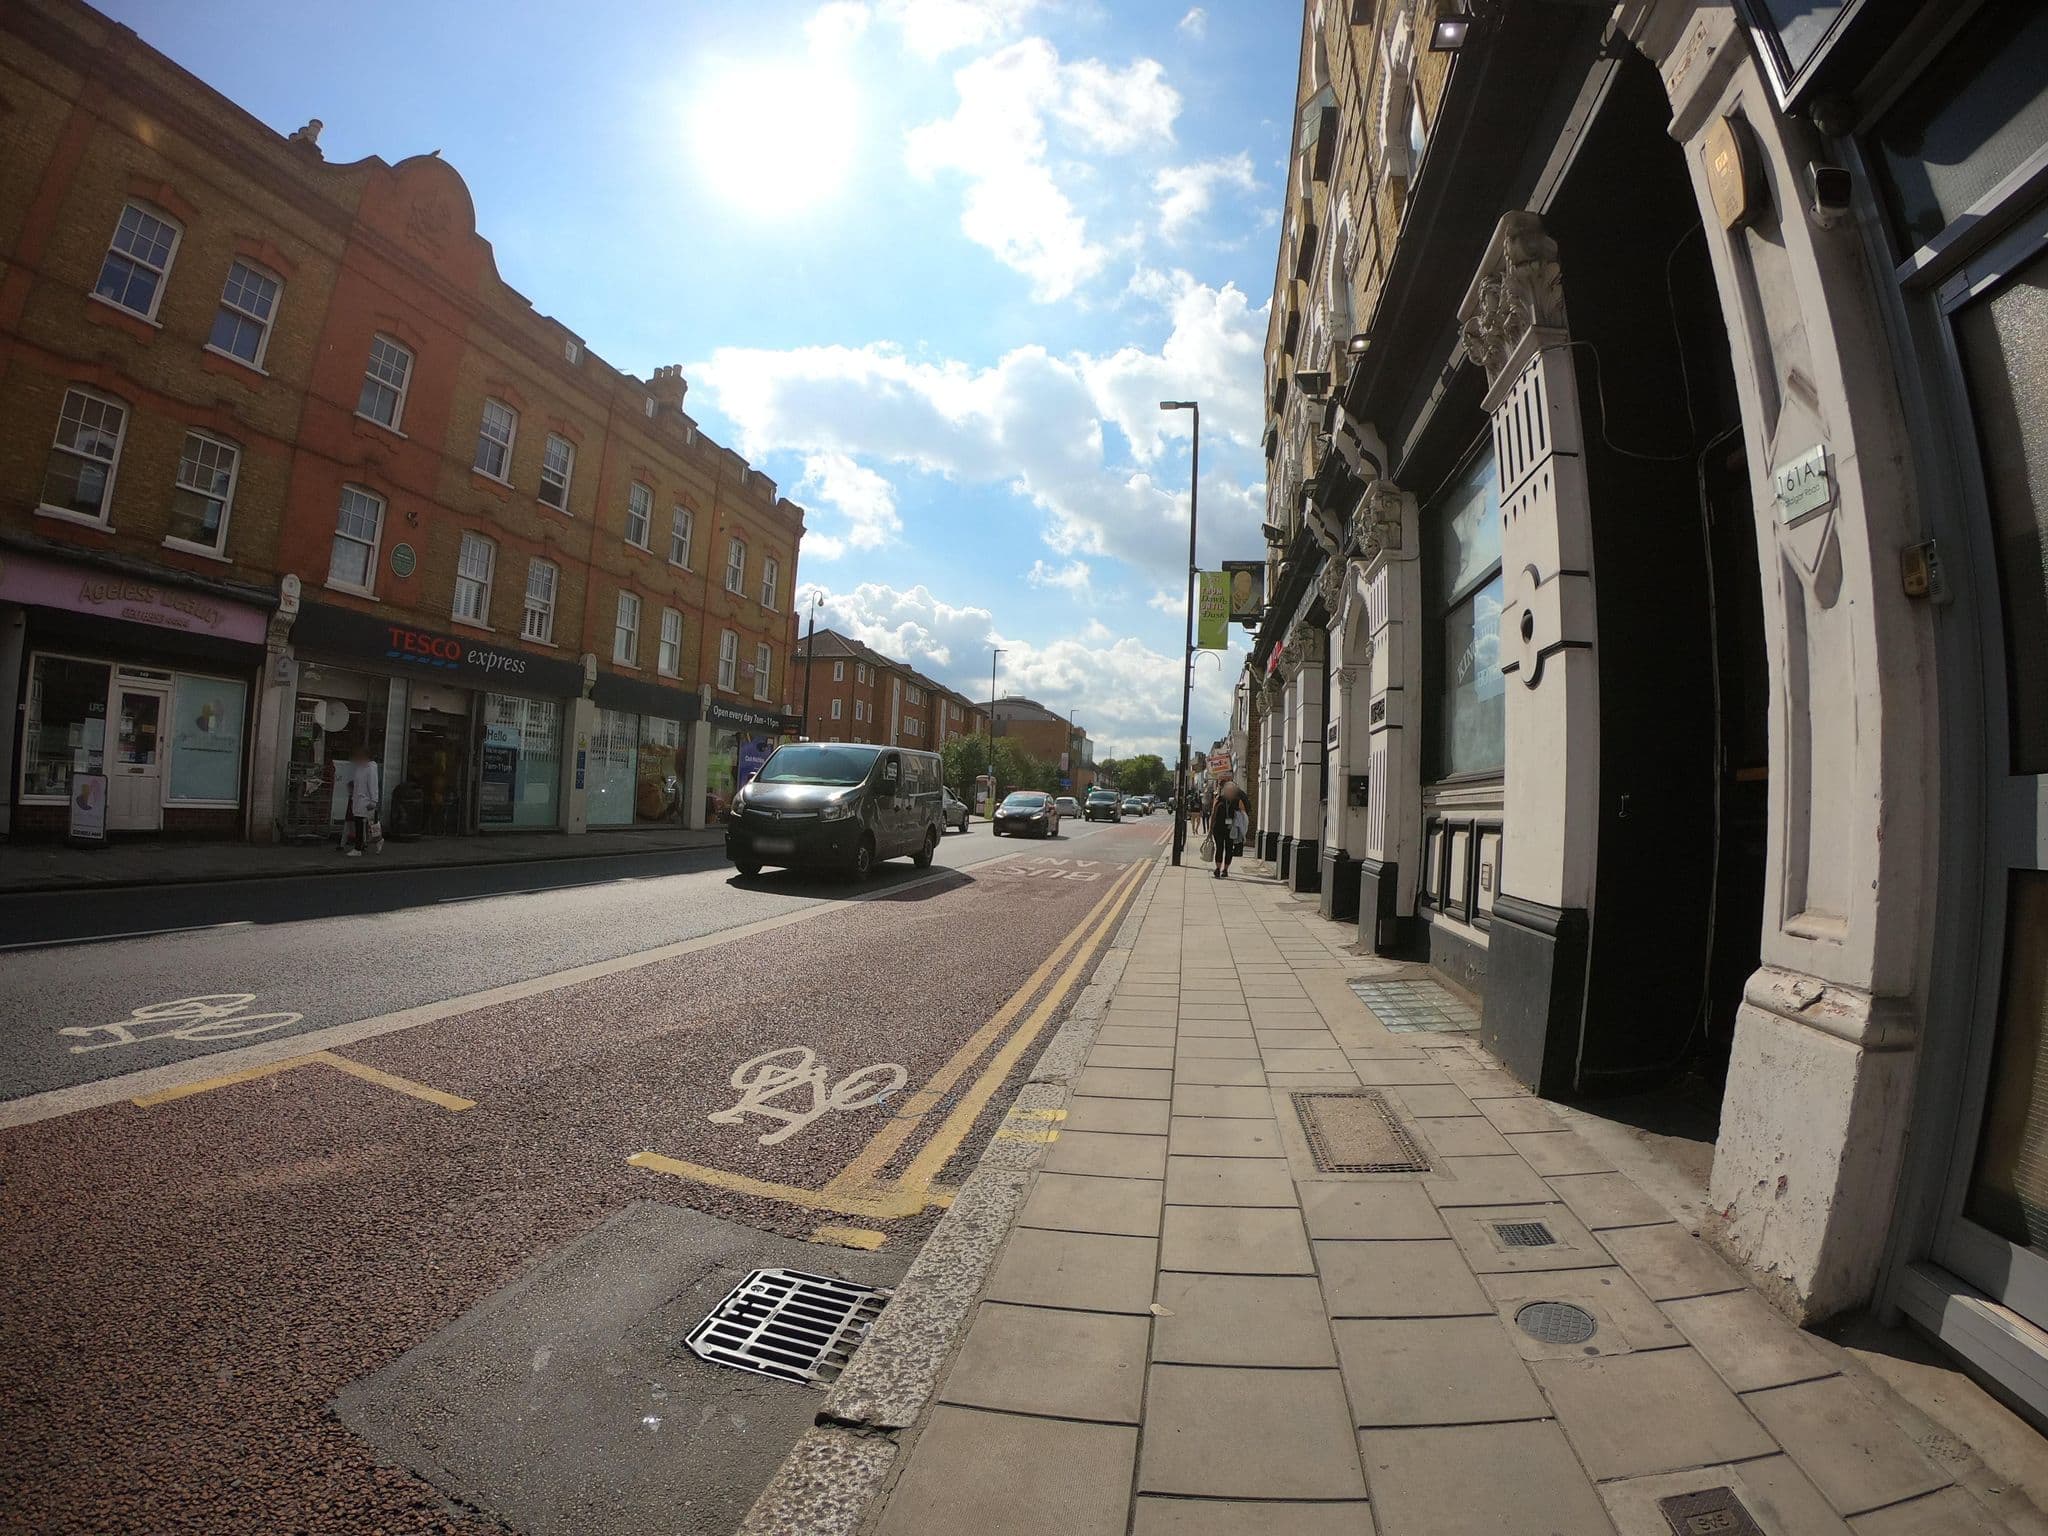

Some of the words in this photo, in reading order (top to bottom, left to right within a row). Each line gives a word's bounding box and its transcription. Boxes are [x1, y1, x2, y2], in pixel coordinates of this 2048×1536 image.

[1778, 461, 1816, 496] 161A
[80, 577, 159, 605] Ageless
[388, 626, 463, 660] TESCO
[467, 648, 527, 674] express
[713, 705, 729, 718] Open
[728, 710, 744, 722] every
[743, 711, 753, 724] day
[487, 728, 508, 742] Hello
